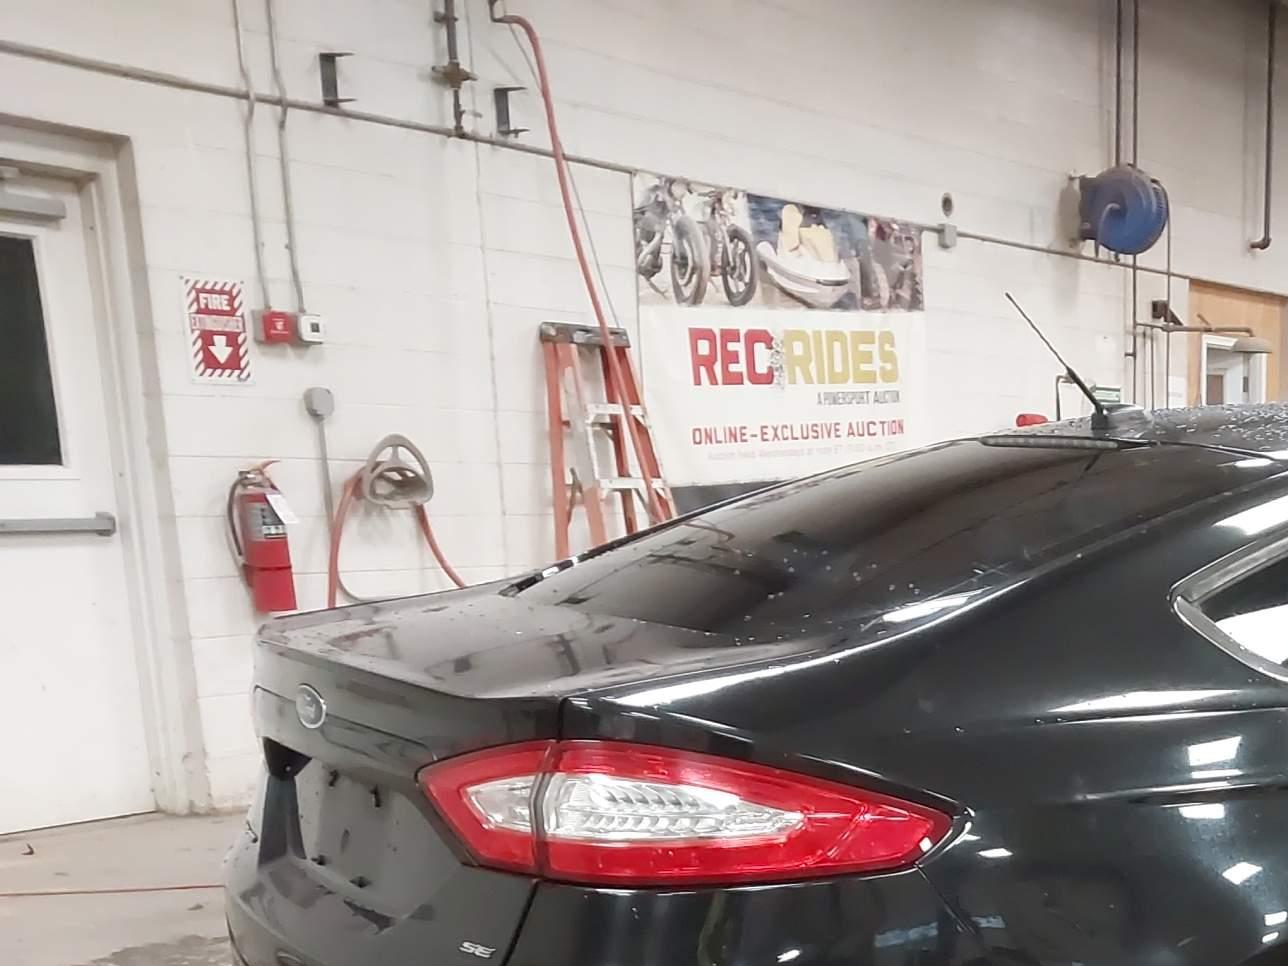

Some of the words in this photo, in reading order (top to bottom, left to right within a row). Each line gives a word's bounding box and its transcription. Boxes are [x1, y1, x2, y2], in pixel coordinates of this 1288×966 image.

[198, 292, 232, 311] FIRE
[688, 327, 775, 386] REC
[783, 328, 900, 385] RIDES
[691, 421, 842, 446] ONLINE-EXCLUSIVE
[847, 418, 905, 438] AUCTION
[459, 941, 497, 958] SE
